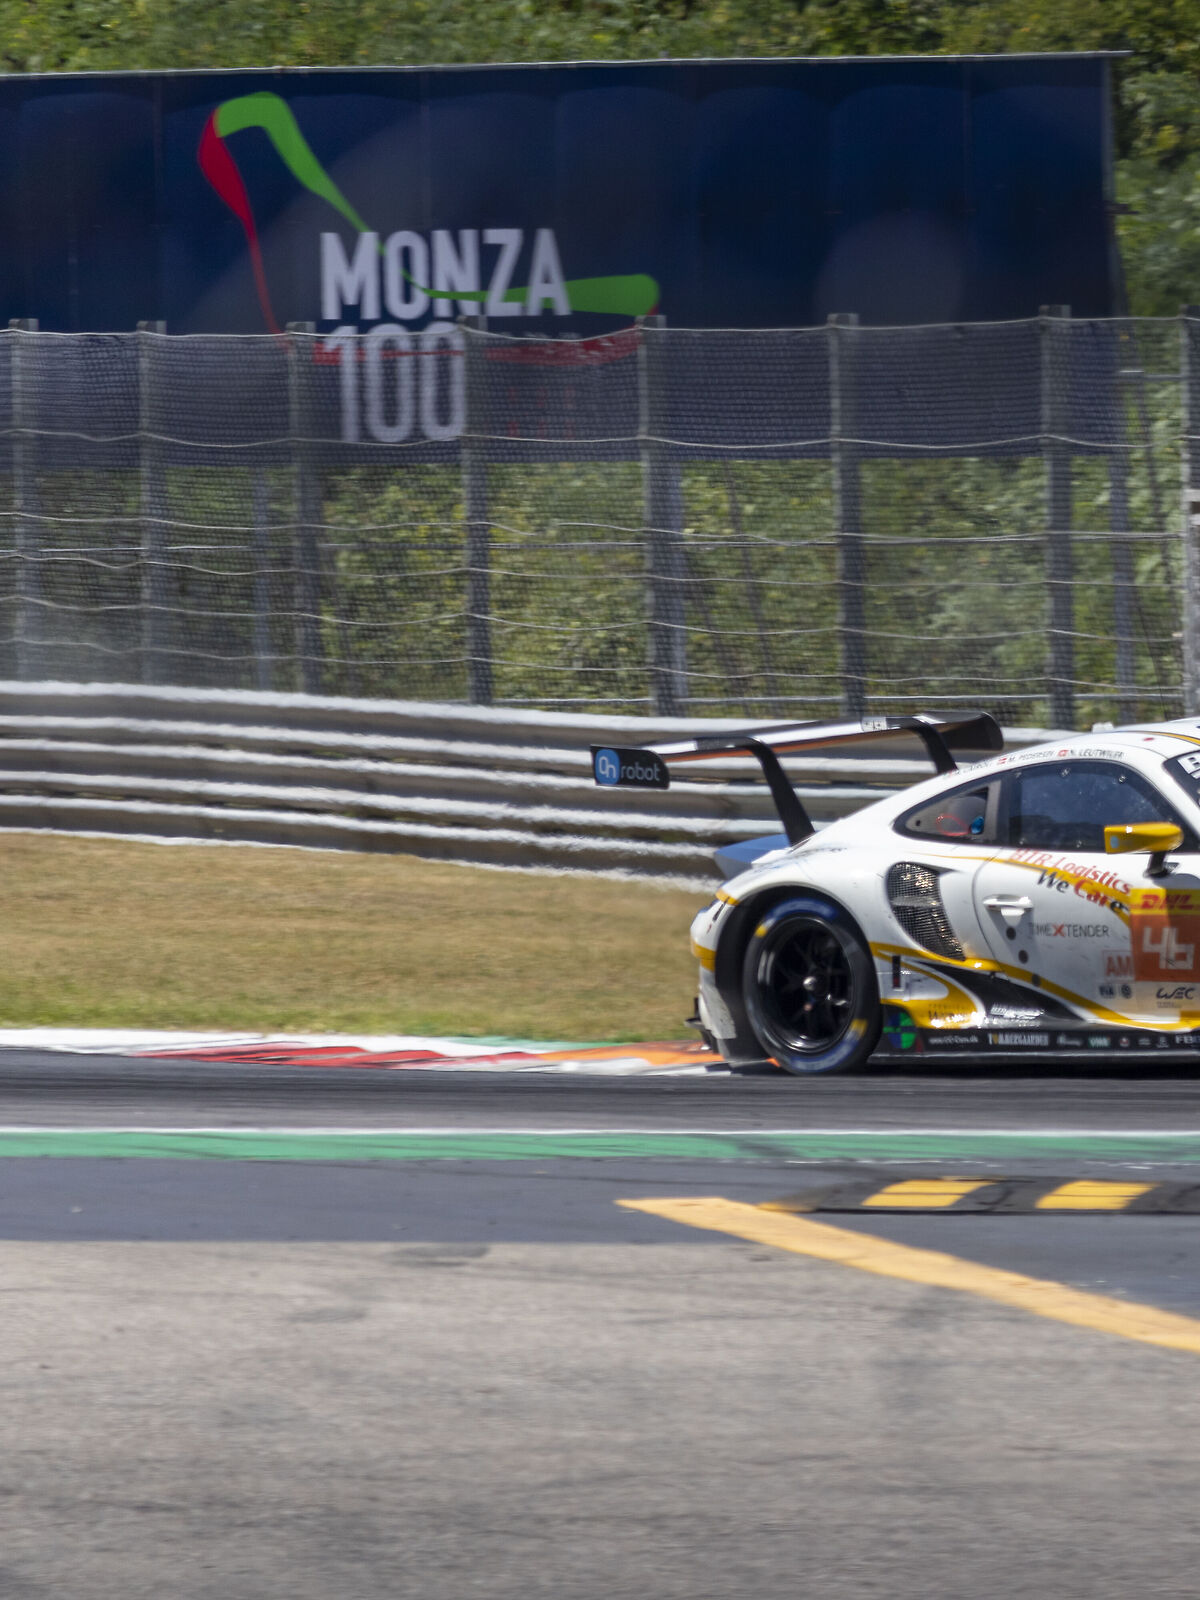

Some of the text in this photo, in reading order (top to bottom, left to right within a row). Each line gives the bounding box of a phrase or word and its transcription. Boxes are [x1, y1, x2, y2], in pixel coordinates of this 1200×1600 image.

[320, 228, 571, 320] MONZA
[325, 324, 467, 442] 100
[620, 762, 660, 782] robot
[1009, 848, 1133, 895] BTR-Logistics
[1036, 870, 1130, 914] We Care
[1141, 894, 1195, 909] DHL
[1106, 955, 1133, 977] AM
[1142, 926, 1195, 970] 46
[1156, 987, 1197, 999] WEC
